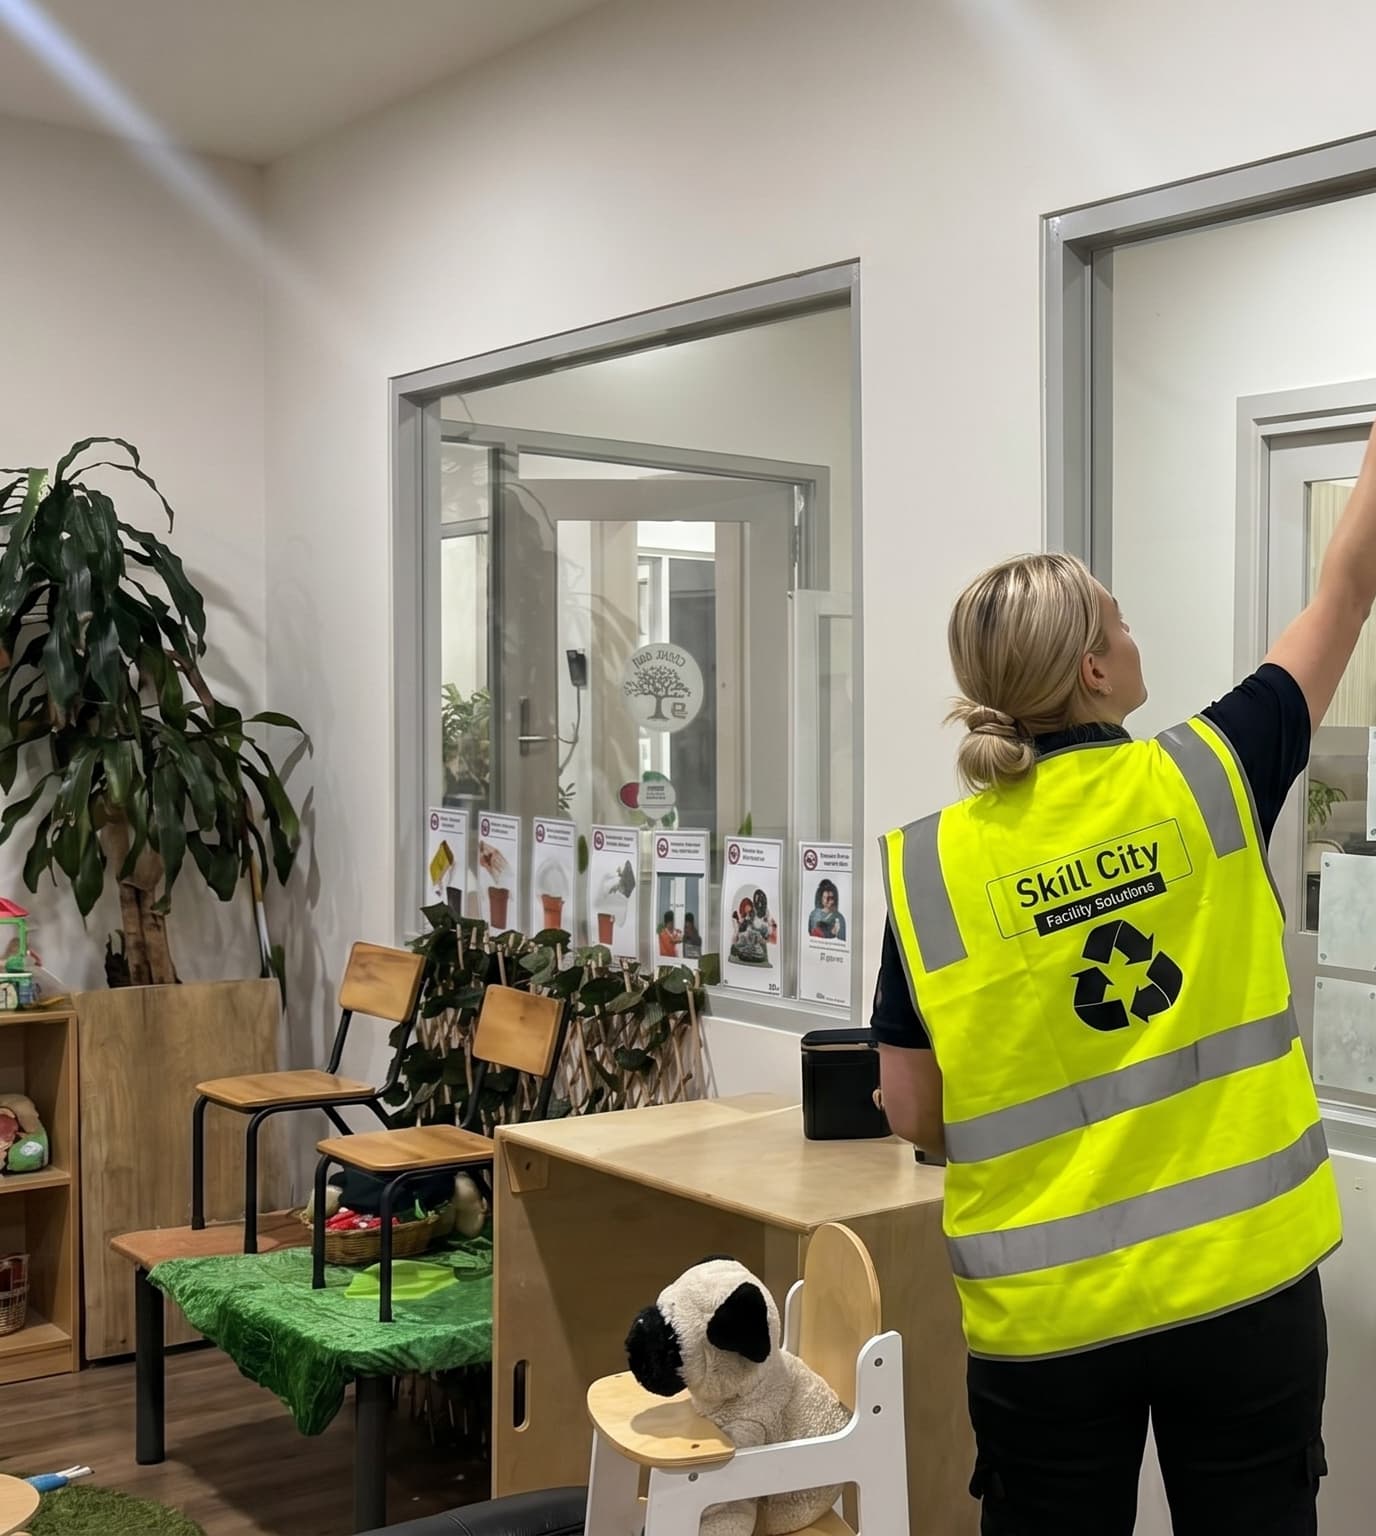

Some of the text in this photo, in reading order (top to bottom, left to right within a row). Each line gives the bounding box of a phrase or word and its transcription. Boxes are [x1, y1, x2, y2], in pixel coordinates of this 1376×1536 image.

[1016, 842, 1158, 908] Skill City
[1046, 882, 1155, 928] Facility Solutions
